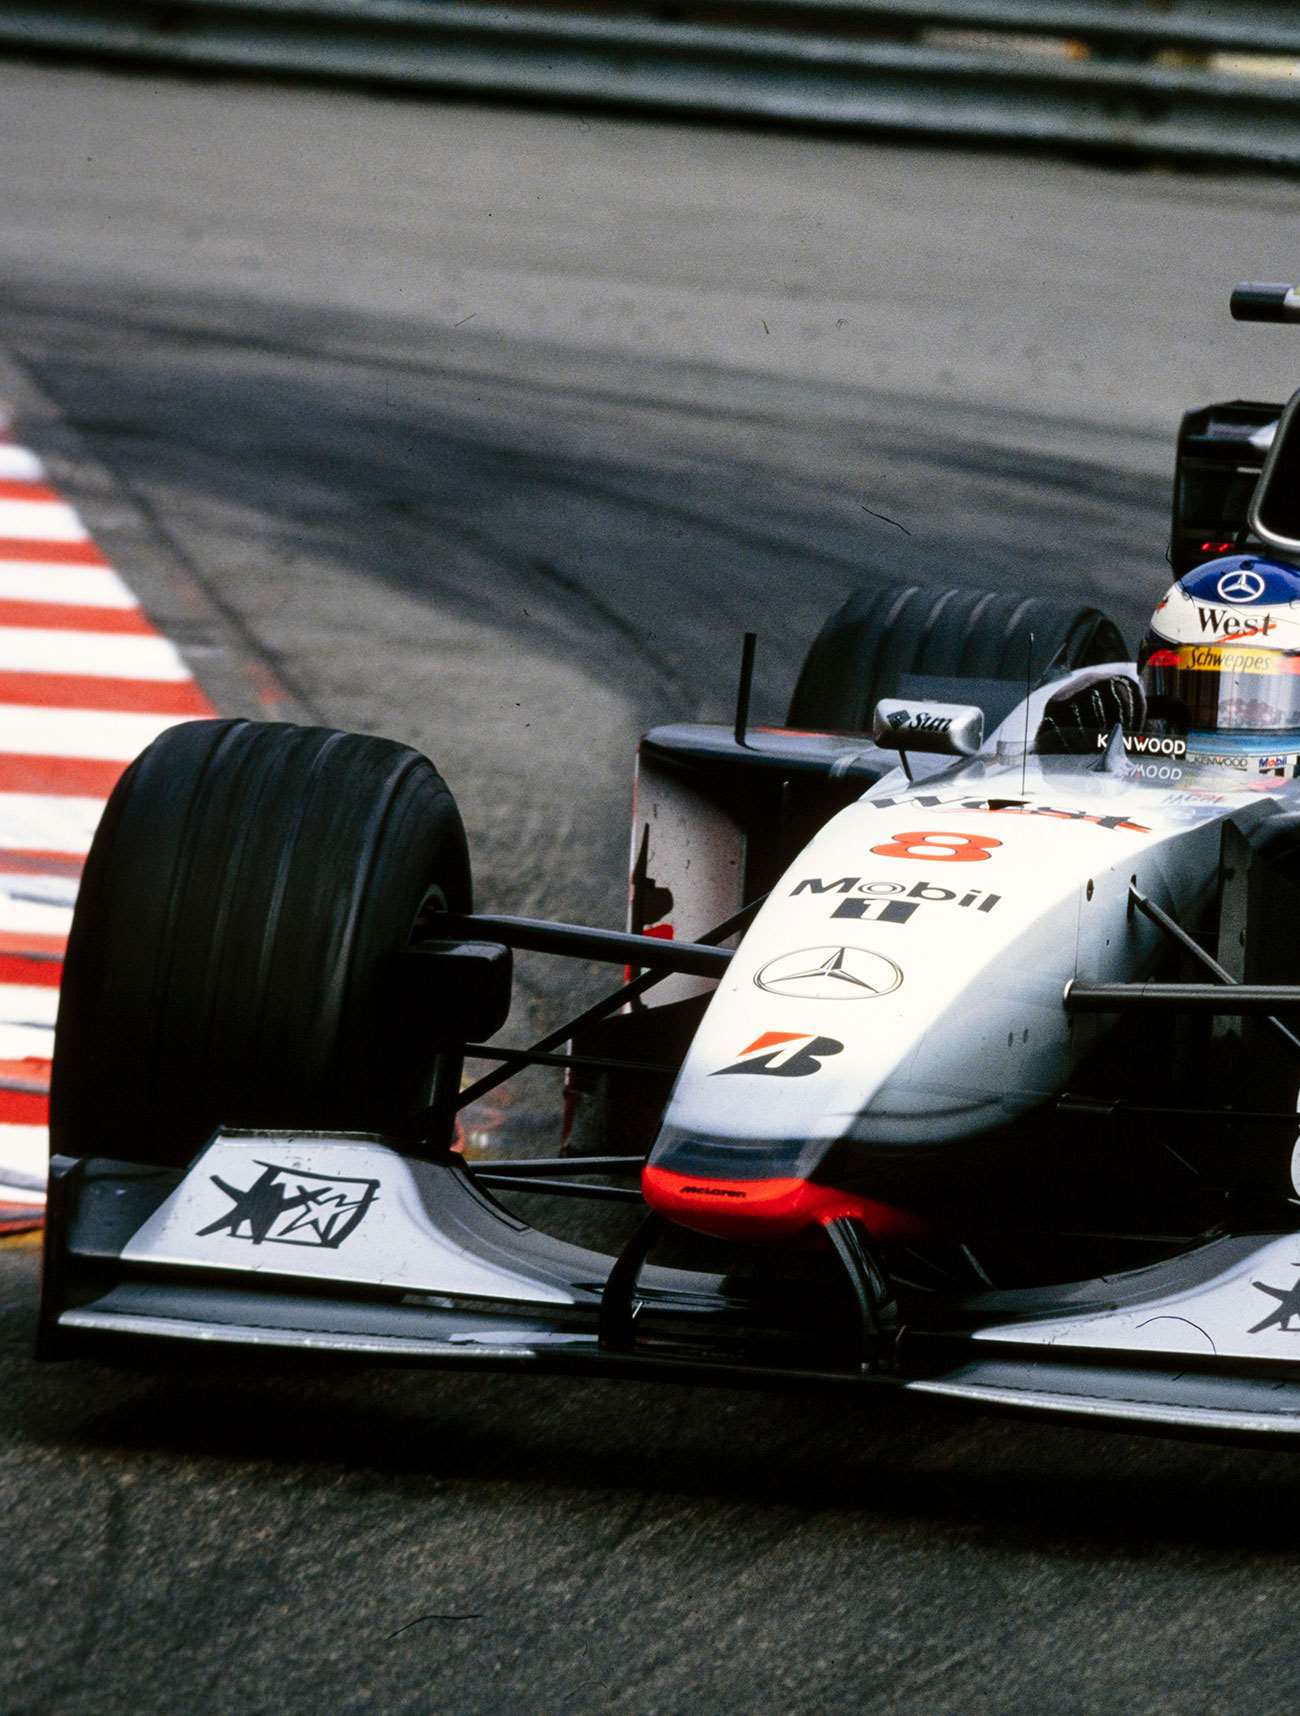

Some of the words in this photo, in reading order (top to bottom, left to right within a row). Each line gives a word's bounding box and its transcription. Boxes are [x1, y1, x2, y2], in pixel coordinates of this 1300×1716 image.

[1198, 607, 1274, 638] West
[1187, 648, 1272, 673] Schweppes
[909, 712, 953, 733] Sun
[1097, 733, 1186, 755] KNWOOD
[869, 831, 1004, 862] 8
[789, 877, 1002, 913] Mobil
